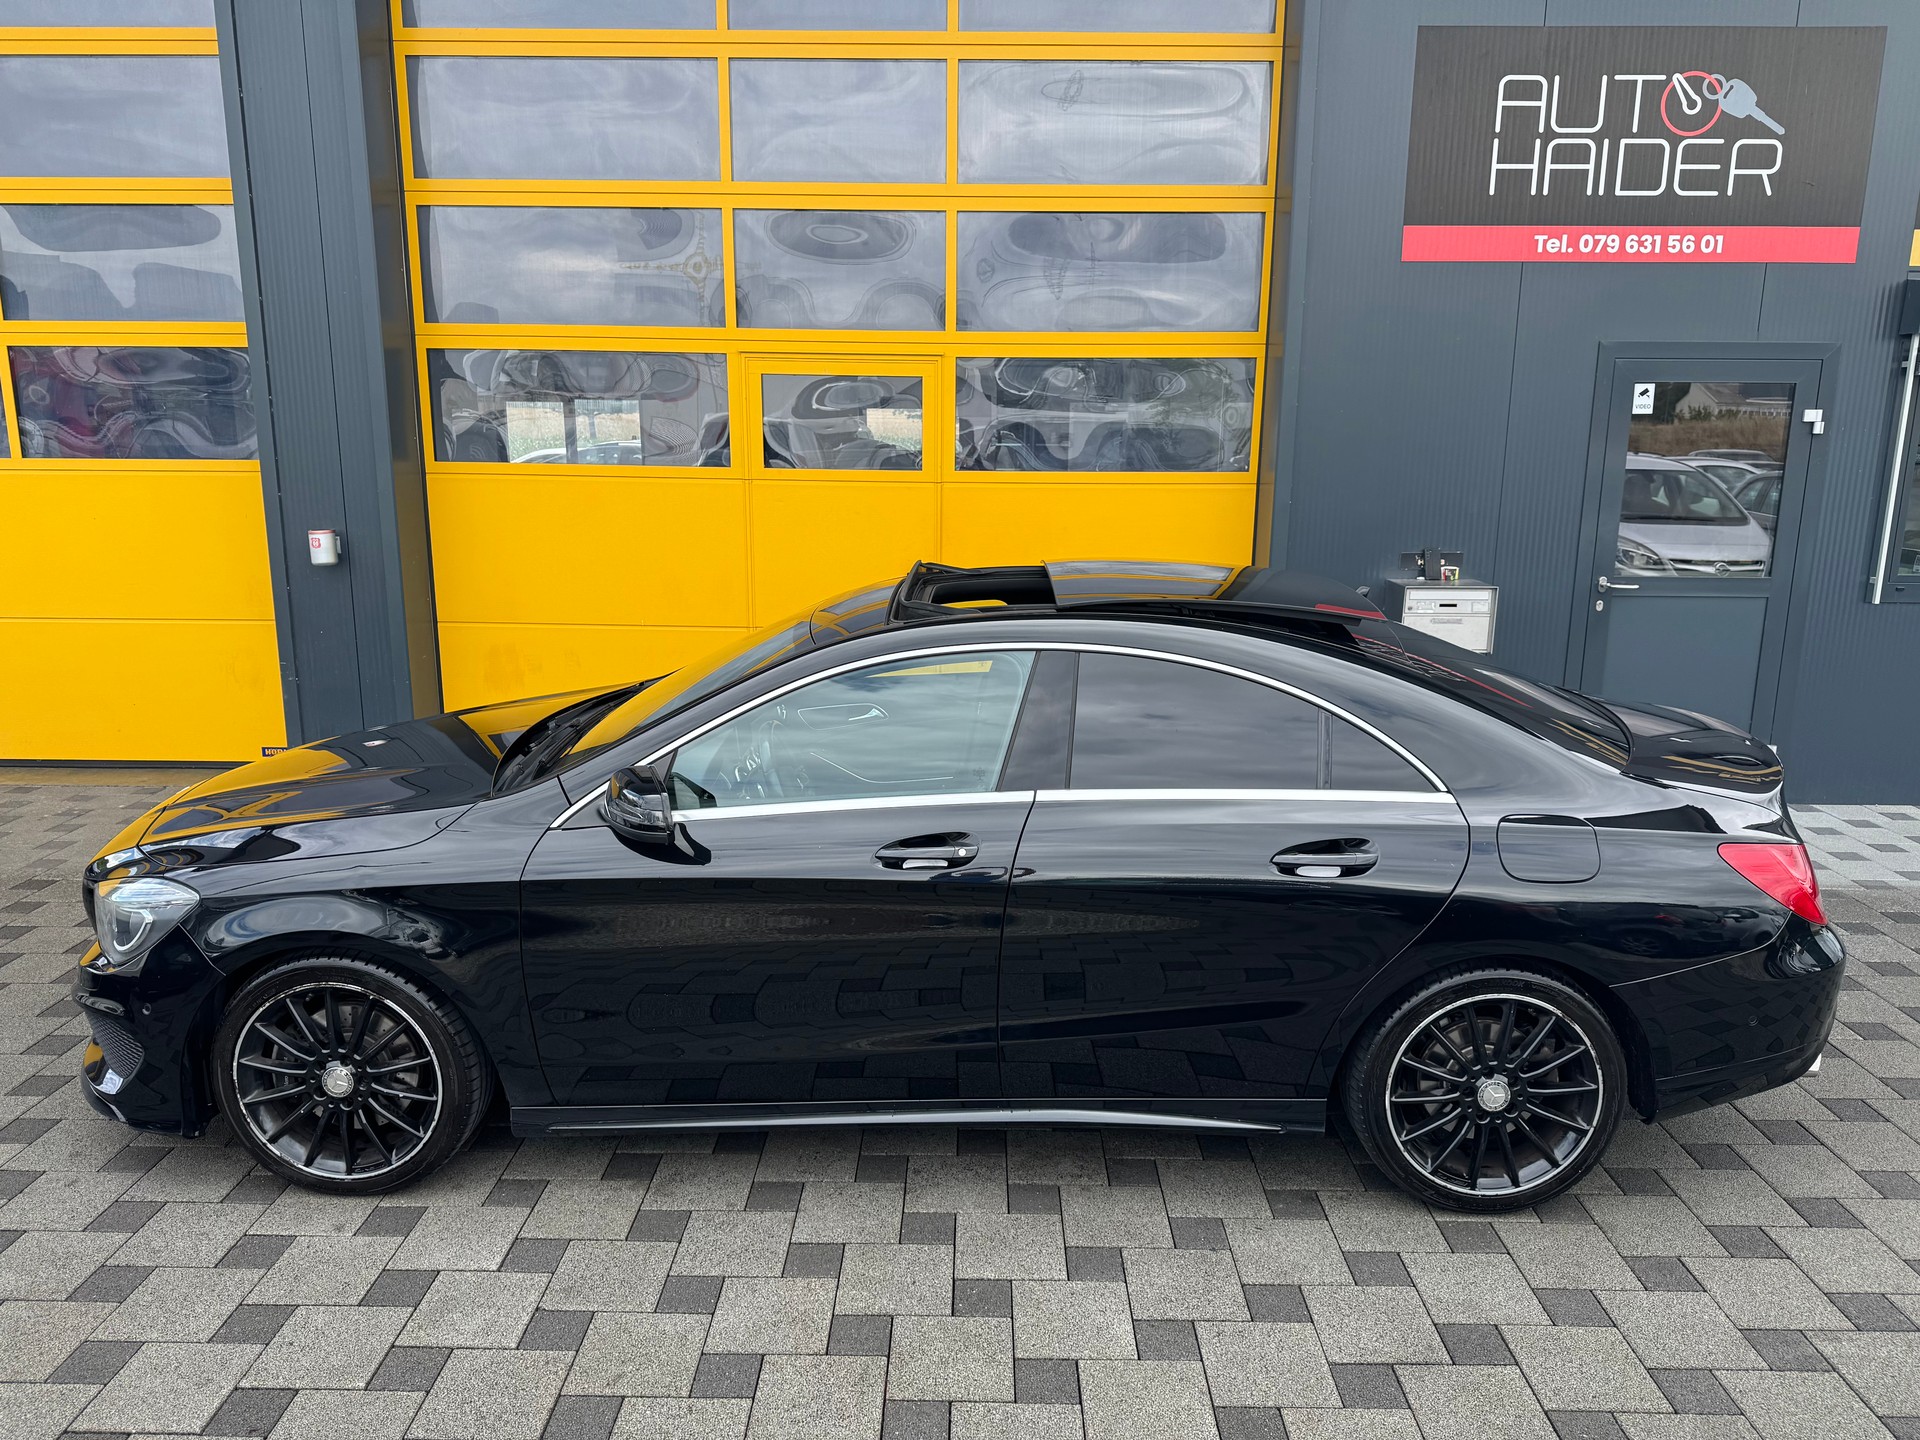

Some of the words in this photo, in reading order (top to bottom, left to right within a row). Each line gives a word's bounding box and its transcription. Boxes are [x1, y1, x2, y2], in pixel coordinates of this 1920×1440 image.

[1488, 138, 1784, 197] HAIDER
[1534, 234, 1574, 253] Tel.
[1579, 234, 1620, 254] 079
[1625, 234, 1662, 254] 631
[1667, 234, 1696, 254] 56
[1700, 234, 1724, 254] 01
